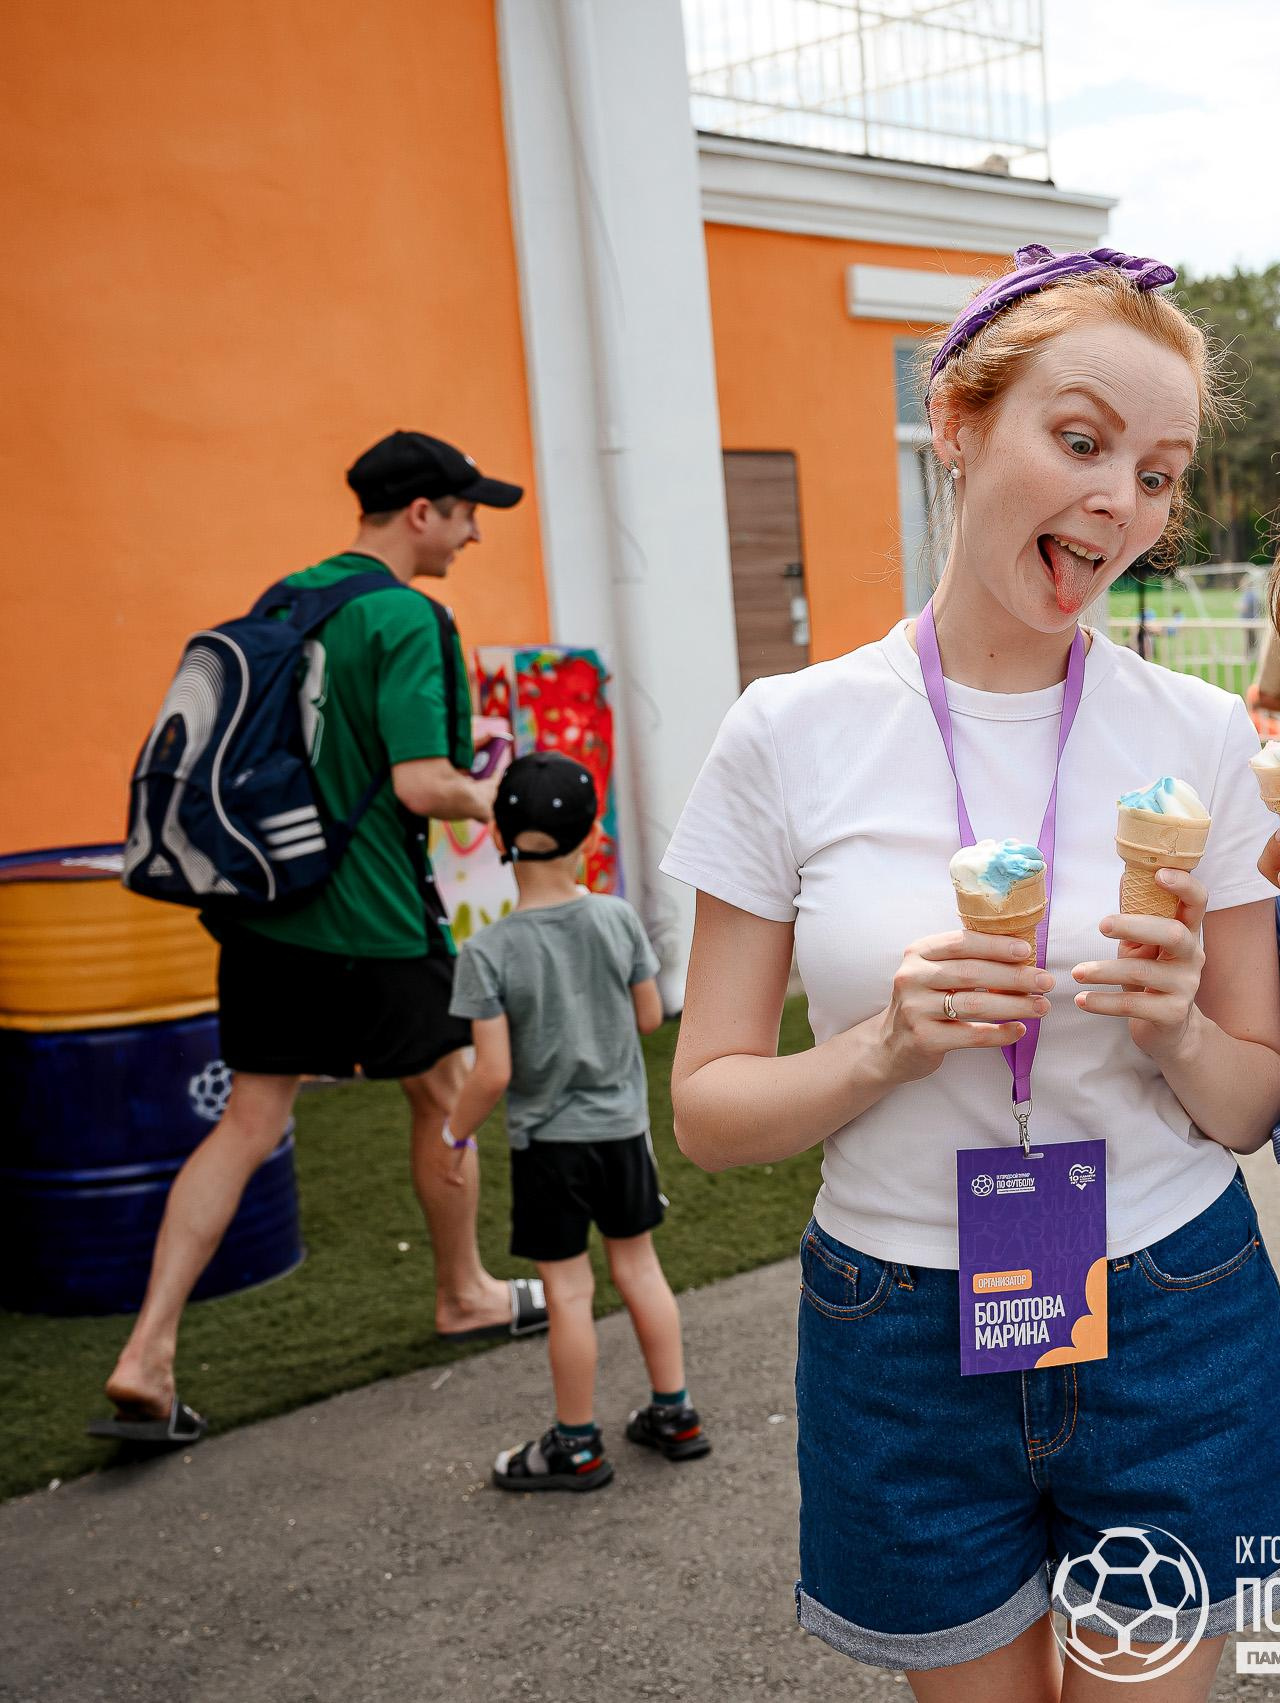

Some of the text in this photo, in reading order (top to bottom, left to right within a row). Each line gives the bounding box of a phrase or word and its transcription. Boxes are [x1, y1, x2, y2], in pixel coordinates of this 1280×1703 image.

[1006, 1177, 1035, 1188] ФУТБОЛУ
[977, 1274, 1027, 1289] ОРГАНИЗАТОР
[974, 1294, 1066, 1327] БОЛОТОВА
[975, 1320, 1051, 1350] МАРИНА
